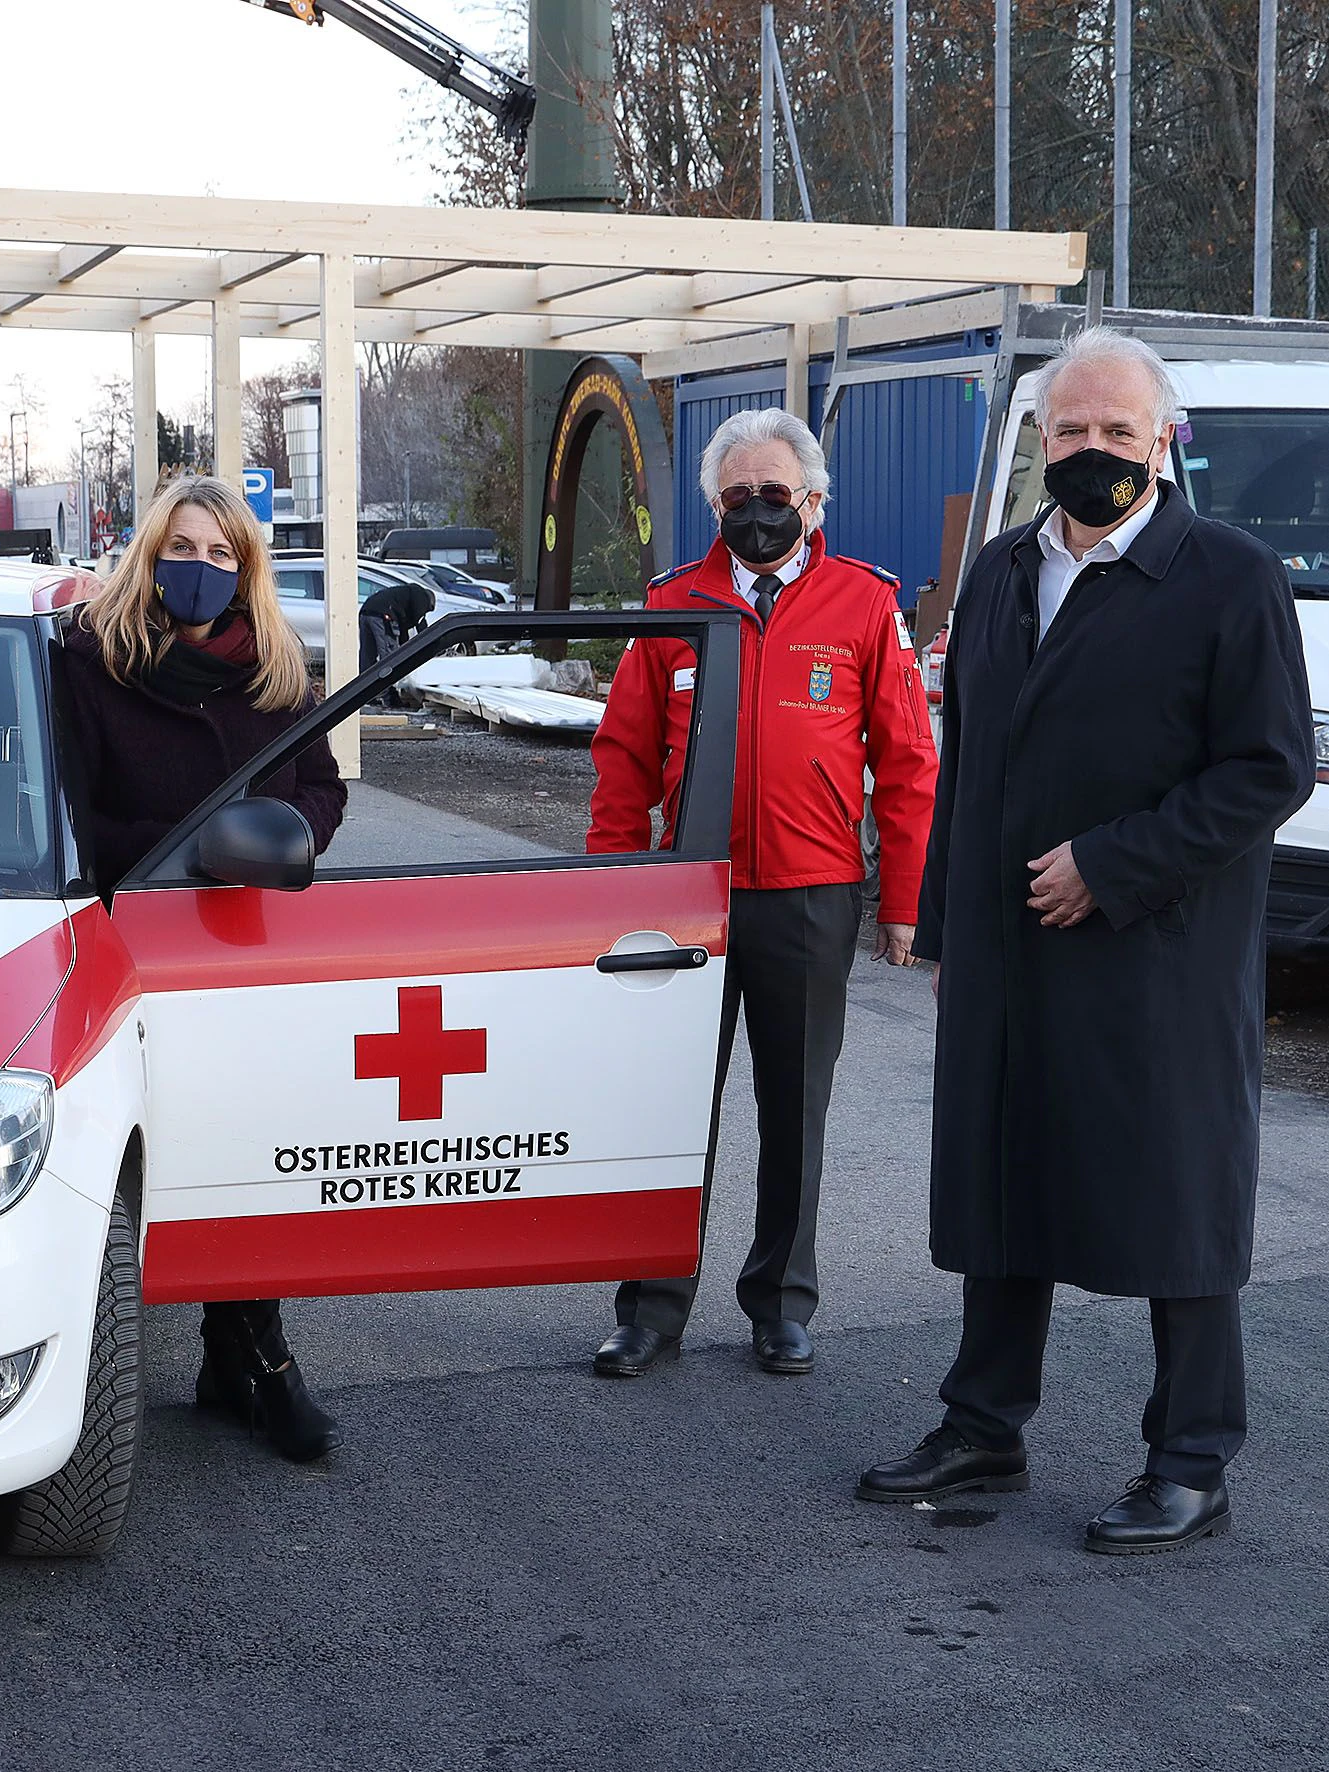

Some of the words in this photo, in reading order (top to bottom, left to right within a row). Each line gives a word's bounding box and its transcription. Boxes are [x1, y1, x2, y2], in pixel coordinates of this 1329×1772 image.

[244, 473, 267, 495] P
[274, 1131, 570, 1174] ÖSTERREICHISCHES
[321, 1174, 415, 1205] ROTES
[425, 1168, 521, 1198] KREUZ
